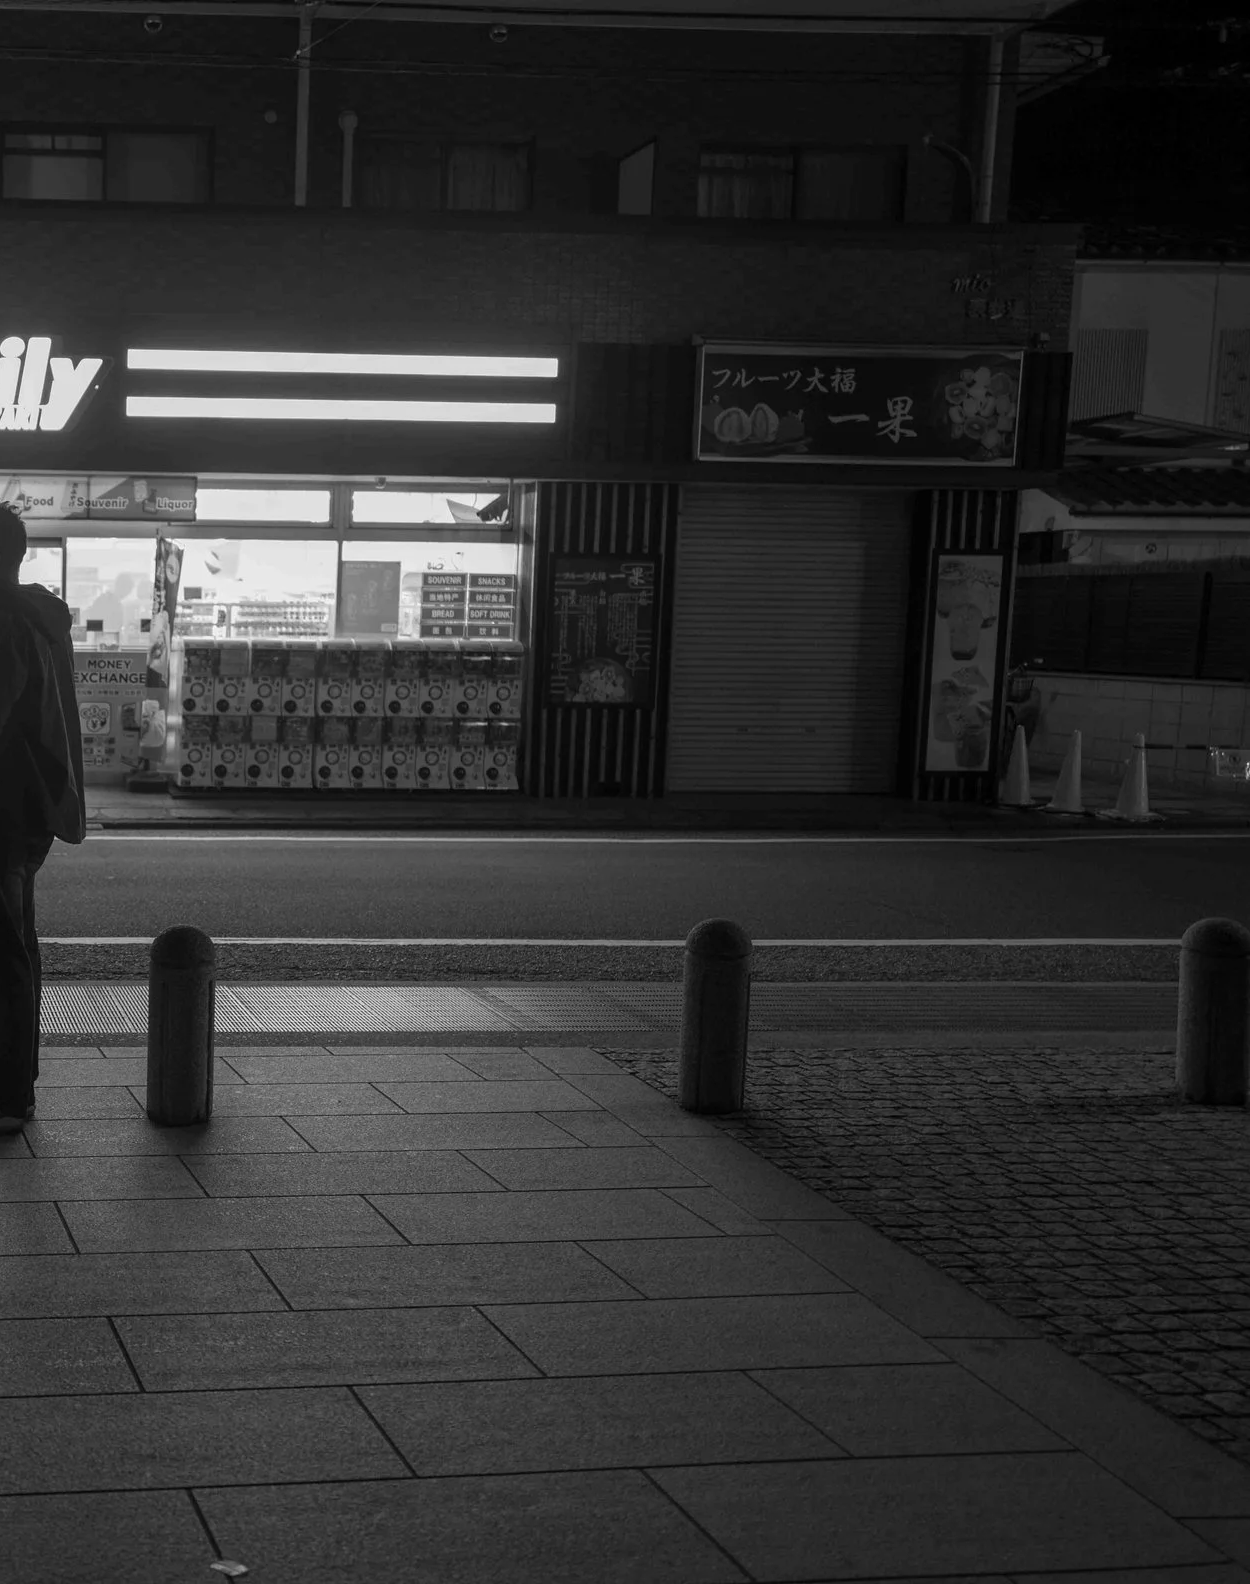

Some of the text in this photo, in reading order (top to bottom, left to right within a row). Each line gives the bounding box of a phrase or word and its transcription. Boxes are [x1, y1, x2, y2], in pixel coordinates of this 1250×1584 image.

[712, 367, 858, 394] フルーツ大福
[828, 396, 918, 443] 一果
[26, 497, 53, 507] Food
[77, 497, 127, 509] Souvenir
[157, 500, 193, 511] Liquor
[427, 576, 462, 584] SOUVENIR
[477, 577, 506, 586] SNACKS
[431, 610, 455, 618] BREAD
[470, 610, 510, 618] SOFT DRINK
[87, 659, 131, 669] MONEY
[73, 672, 145, 684] EXCHANGE
